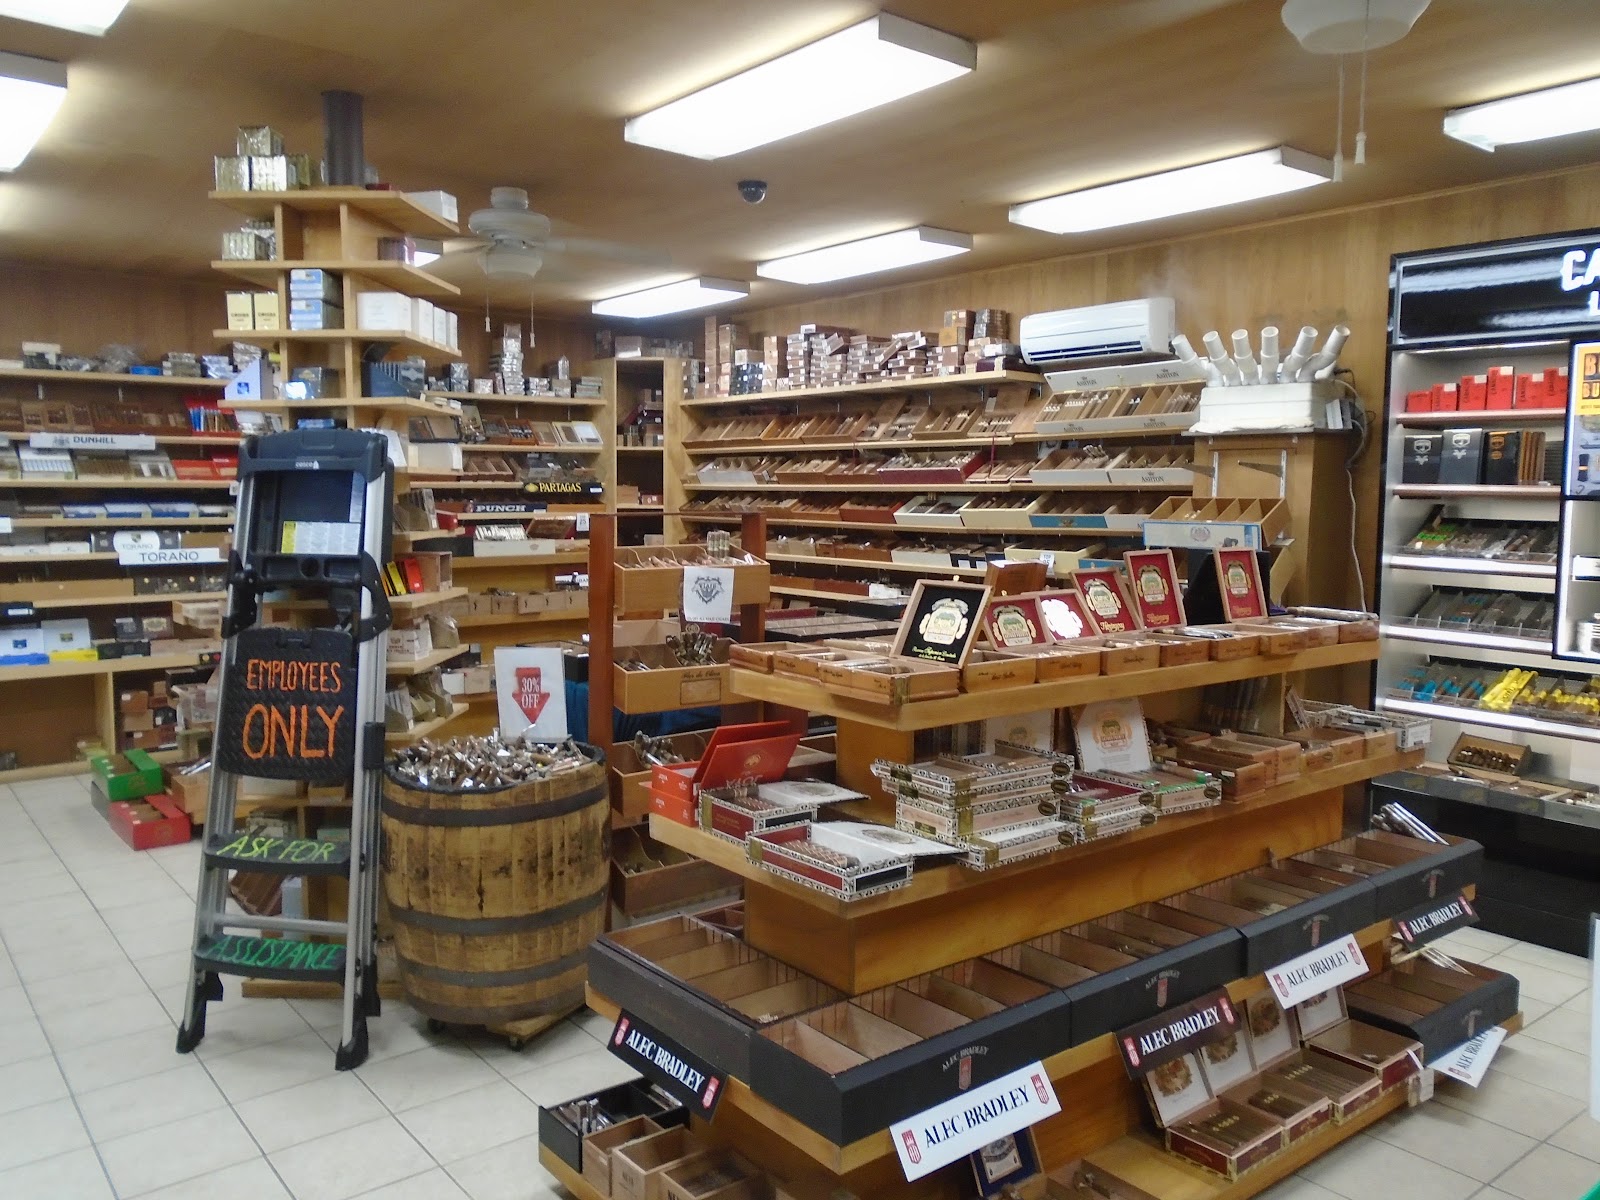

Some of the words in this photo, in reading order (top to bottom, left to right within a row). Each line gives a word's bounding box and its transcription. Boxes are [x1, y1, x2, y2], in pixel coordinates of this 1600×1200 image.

[1076, 379, 1097, 388] ASHTON
[1156, 371, 1179, 379] ASHTON
[73, 436, 116, 444] DUNHILL
[539, 482, 582, 493] PARTAGAS
[1141, 475, 1164, 483] ASHTON
[476, 504, 526, 513] PUNCH
[246, 659, 342, 693] EMPLOYEES
[521, 677, 540, 693] 30%
[521, 693, 540, 709] OFF
[242, 703, 345, 759] ONLY
[216, 835, 284, 859] ASK
[278, 840, 336, 862] FOR
[1408, 915, 1433, 935] ALEC
[1427, 902, 1464, 925] BRADLEY
[204, 934, 346, 970] ASSISTANCE
[1286, 964, 1312, 988] ALEC
[1311, 949, 1350, 978] BRADLEY
[1140, 1027, 1172, 1056] ALEC
[1169, 1006, 1221, 1042] BRADLEY
[625, 1028, 657, 1061] ALEC
[653, 1046, 705, 1093] BRADLEY
[941, 1054, 959, 1072] ALEC
[960, 1045, 990, 1057] BRADLEY
[923, 1114, 965, 1149] ALEC
[963, 1084, 1030, 1129] BRADLEY
